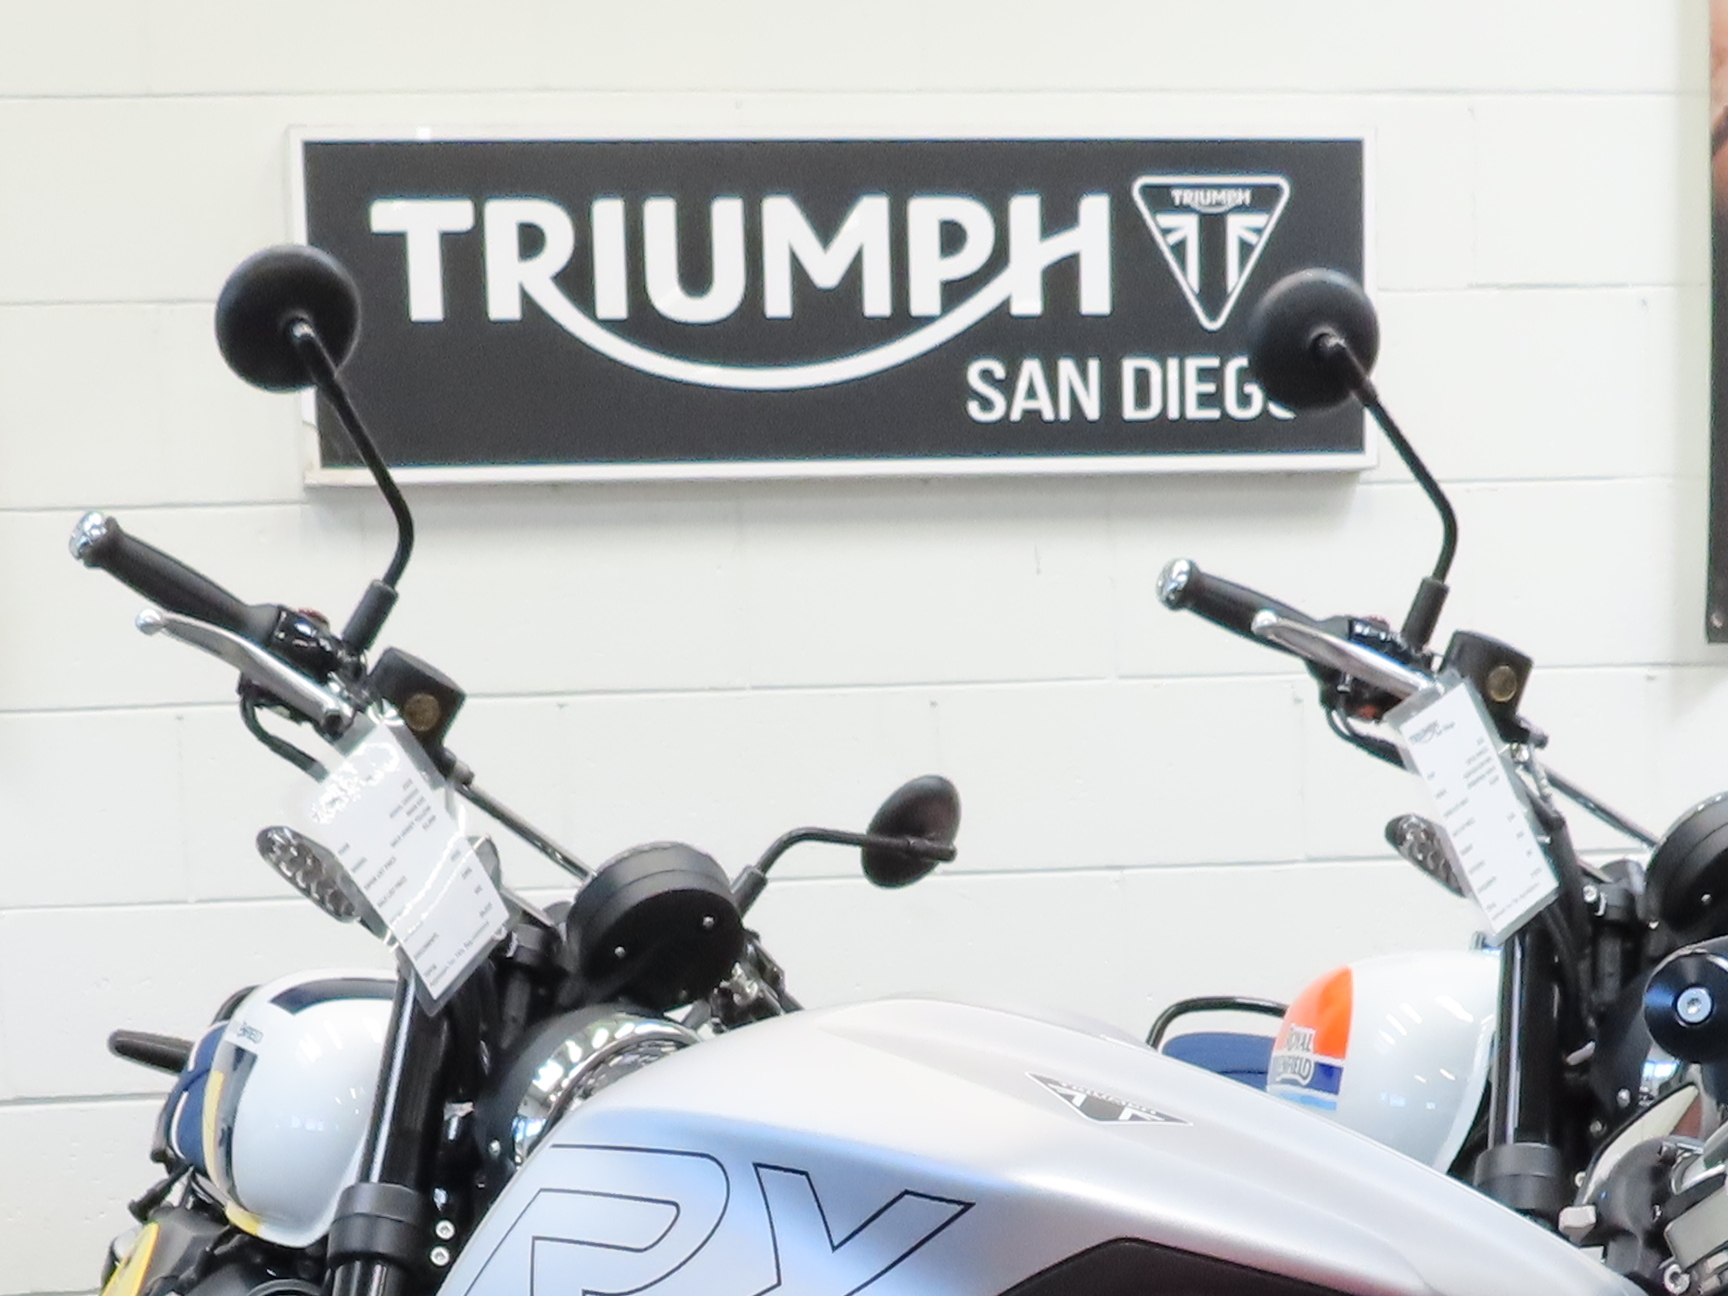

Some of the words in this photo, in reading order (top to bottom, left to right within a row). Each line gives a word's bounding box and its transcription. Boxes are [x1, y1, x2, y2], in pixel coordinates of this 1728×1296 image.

[1172, 190, 1251, 214] TRIUMPH
[369, 193, 1111, 389] TRIUMPH
[967, 356, 1101, 422] SAN
[1122, 356, 1296, 421] DIEG
